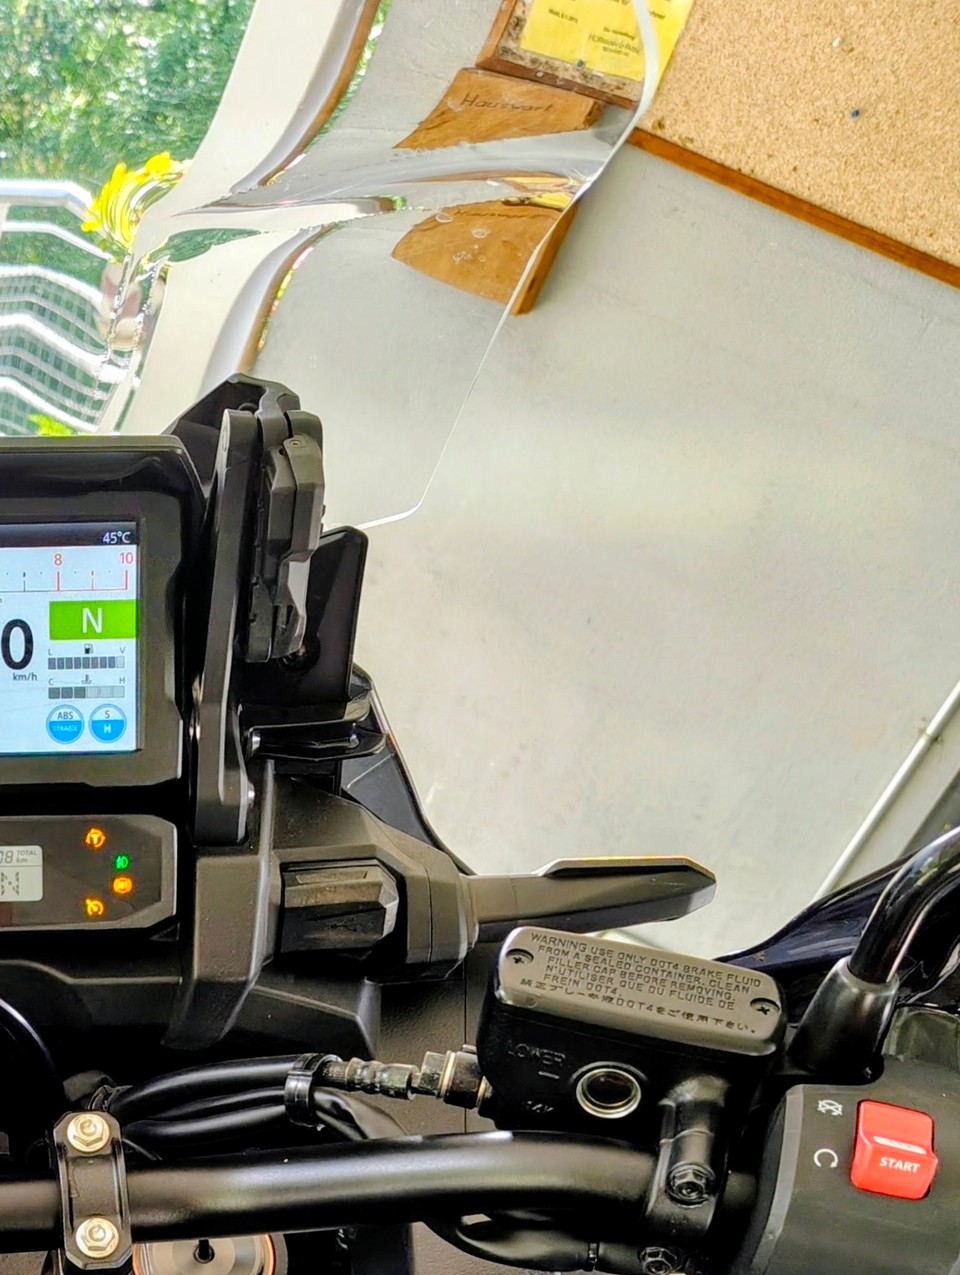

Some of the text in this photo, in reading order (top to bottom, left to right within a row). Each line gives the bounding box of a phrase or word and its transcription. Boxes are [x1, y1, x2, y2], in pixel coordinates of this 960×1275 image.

[459, 92, 554, 112] Hauswart
[102, 532, 131, 544] 45°C
[54, 553, 62, 566] 8
[119, 552, 134, 565] 10
[81, 607, 103, 634] N
[1, 618, 34, 671] 0
[13, 671, 38, 682] km/h
[56, 711, 74, 720] ABS
[104, 710, 111, 719] S
[103, 724, 112, 734] H
[530, 933, 762, 988] WARNING USE ONLY DOT4 BRAKE FLUID
[538, 945, 751, 995] FROM A SEALED CONTAINER. CLEAN
[543, 973, 580, 989] FREIN
[547, 956, 737, 1002] FILLER CAP BEFORE REMOVING.
[619, 979, 644, 992] QUE
[648, 985, 665, 997] DU
[668, 989, 715, 1007] FLUIDE
[718, 999, 735, 1011] DE
[878, 1156, 921, 1174] START
